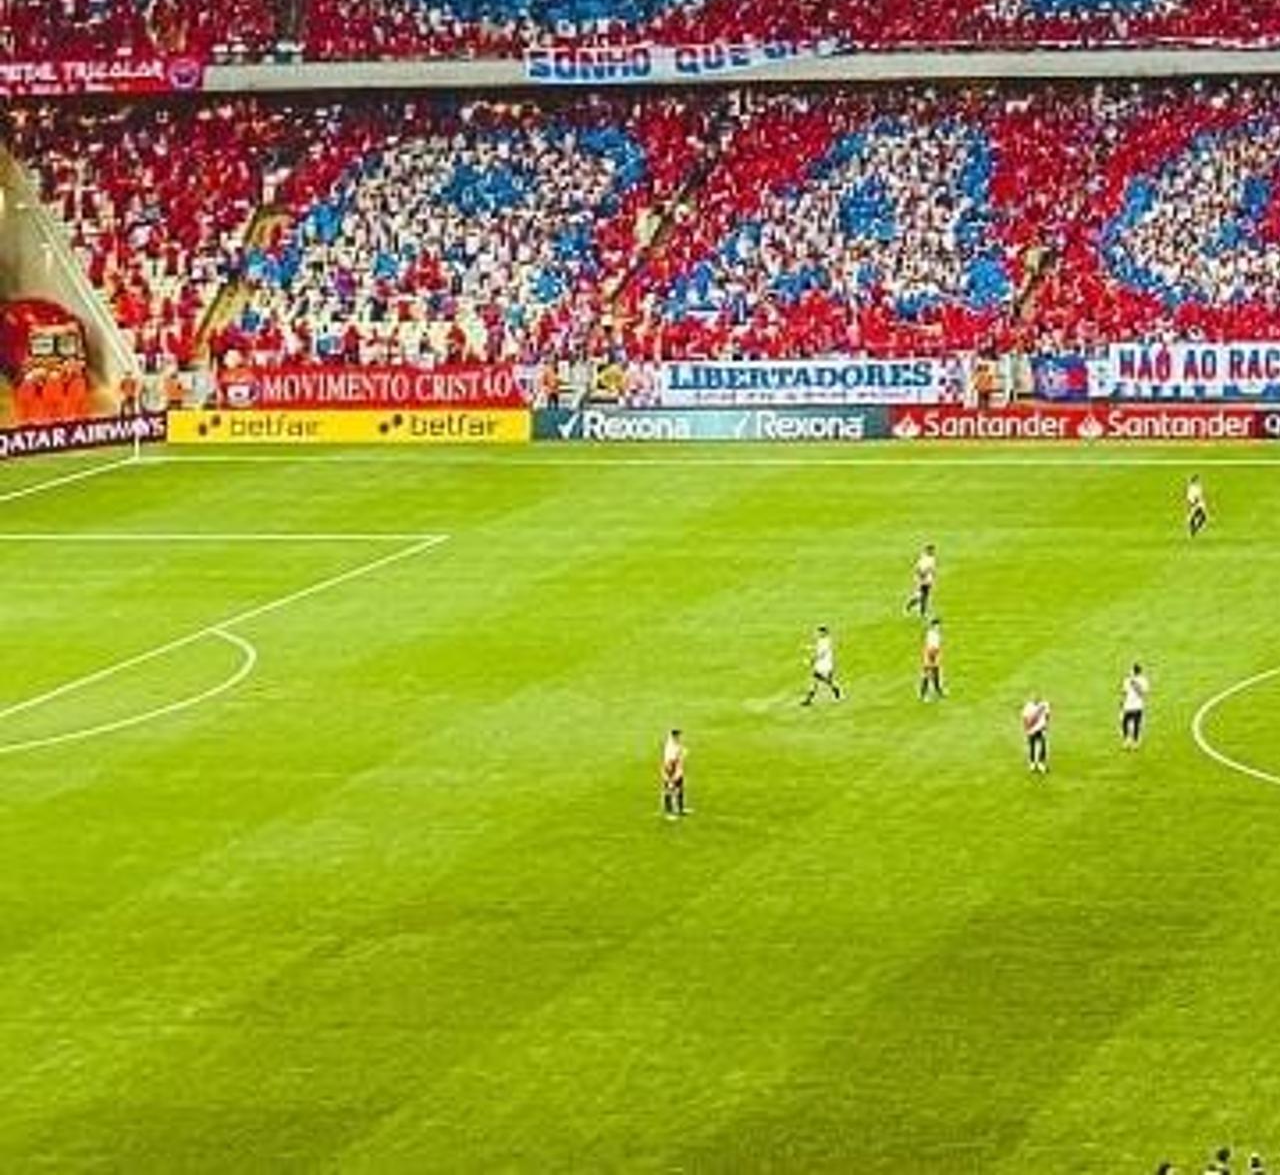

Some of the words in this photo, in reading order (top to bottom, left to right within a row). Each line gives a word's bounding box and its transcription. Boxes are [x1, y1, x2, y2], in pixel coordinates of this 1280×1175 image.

[529, 47, 651, 79] SONHO
[675, 43, 750, 73] QUE
[668, 362, 932, 391] LIBERTADORES
[1183, 349, 1217, 381] AO
[263, 374, 410, 401] MOVIMENTO
[231, 413, 318, 437] betfair
[411, 414, 499, 437] betfair
[583, 411, 692, 439] Rexona
[756, 411, 865, 439] Rexona
[926, 409, 1068, 436] Santander
[1108, 410, 1252, 437] Santander
